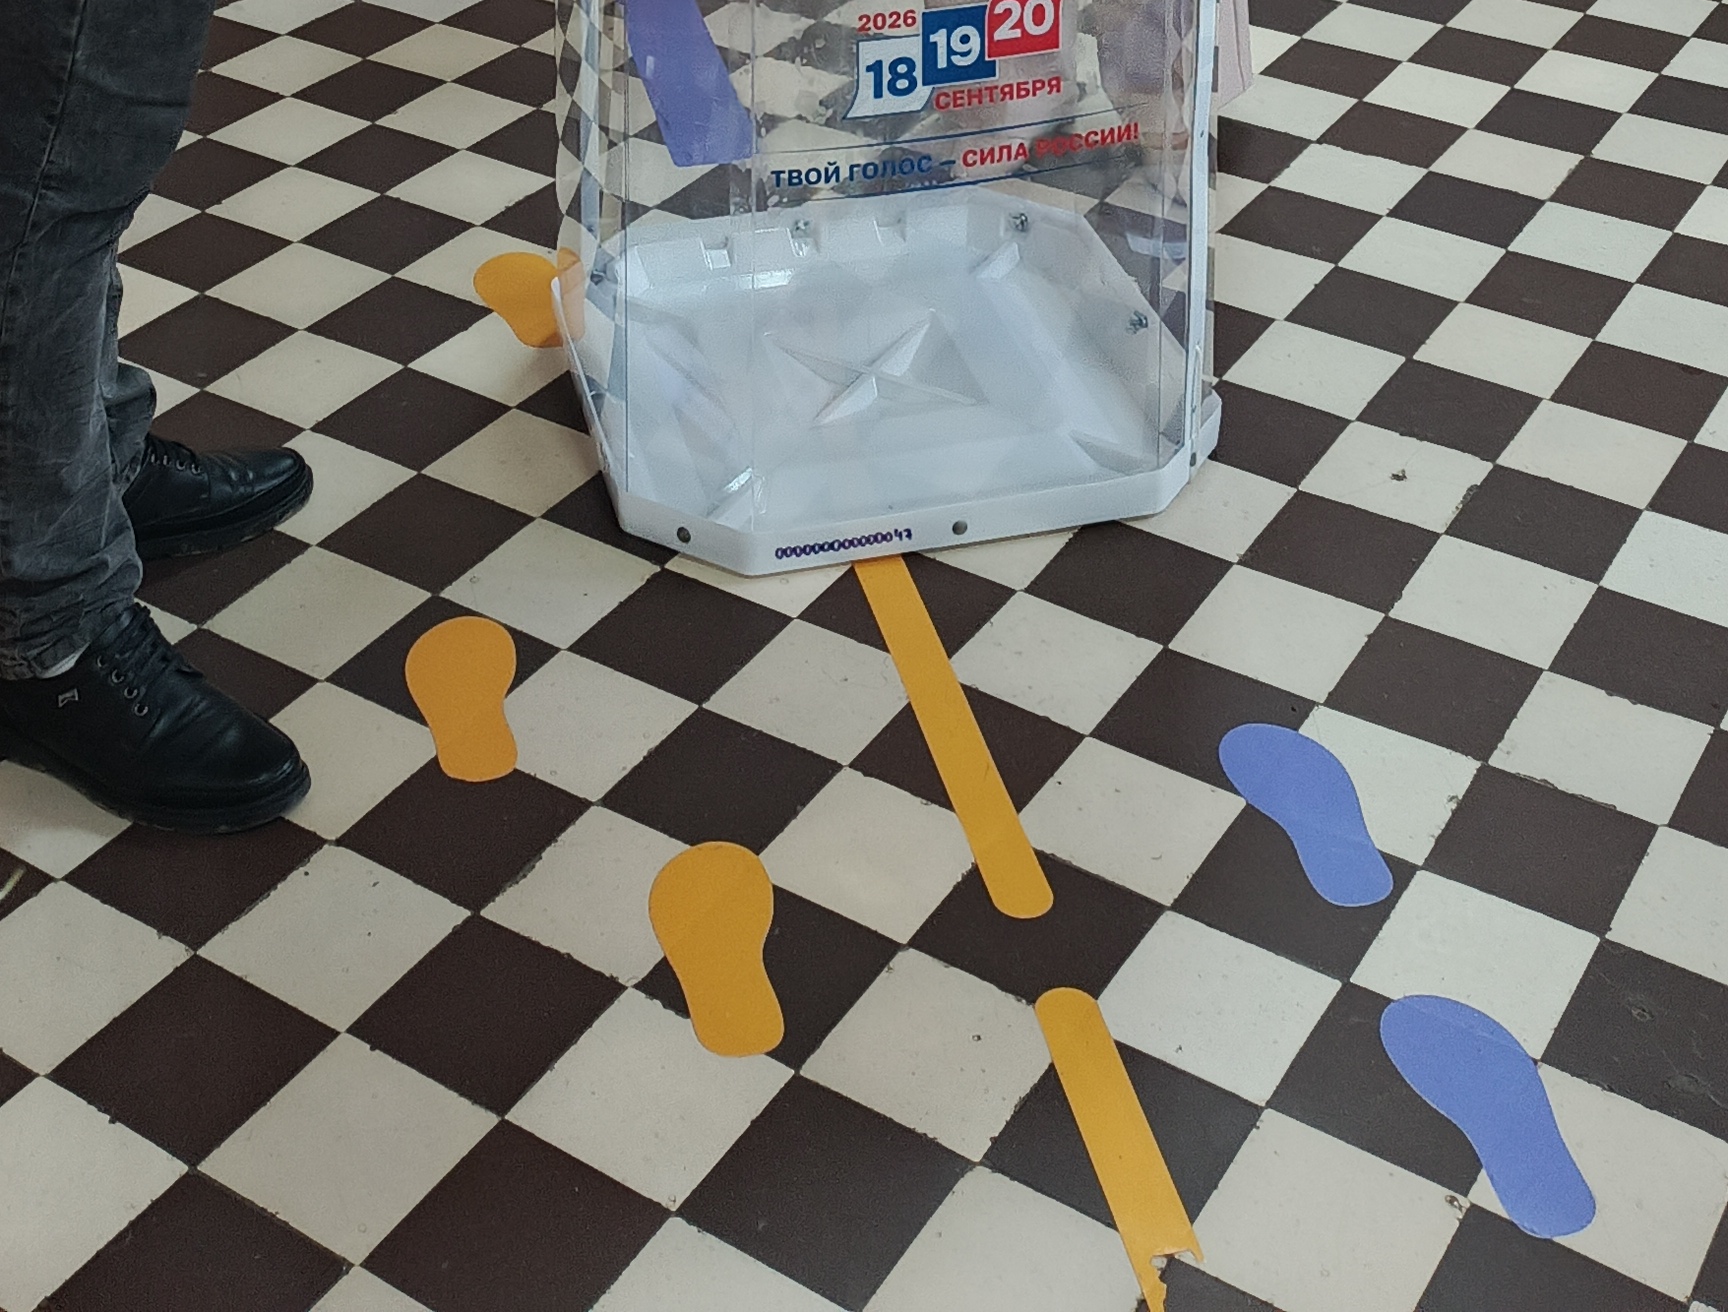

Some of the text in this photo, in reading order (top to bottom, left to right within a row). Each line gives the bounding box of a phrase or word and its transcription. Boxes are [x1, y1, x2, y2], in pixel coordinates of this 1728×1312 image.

[857, 9, 917, 33] 2026
[866, 57, 918, 100] 18
[929, 25, 980, 69] 19
[934, 76, 1062, 111] СЕНТЯБРЯ
[771, 162, 841, 189] ТВОЙ
[849, 154, 932, 182] ГОЛОС
[961, 142, 1028, 169] СИЛА
[1035, 122, 1139, 155] РОССИИ!
